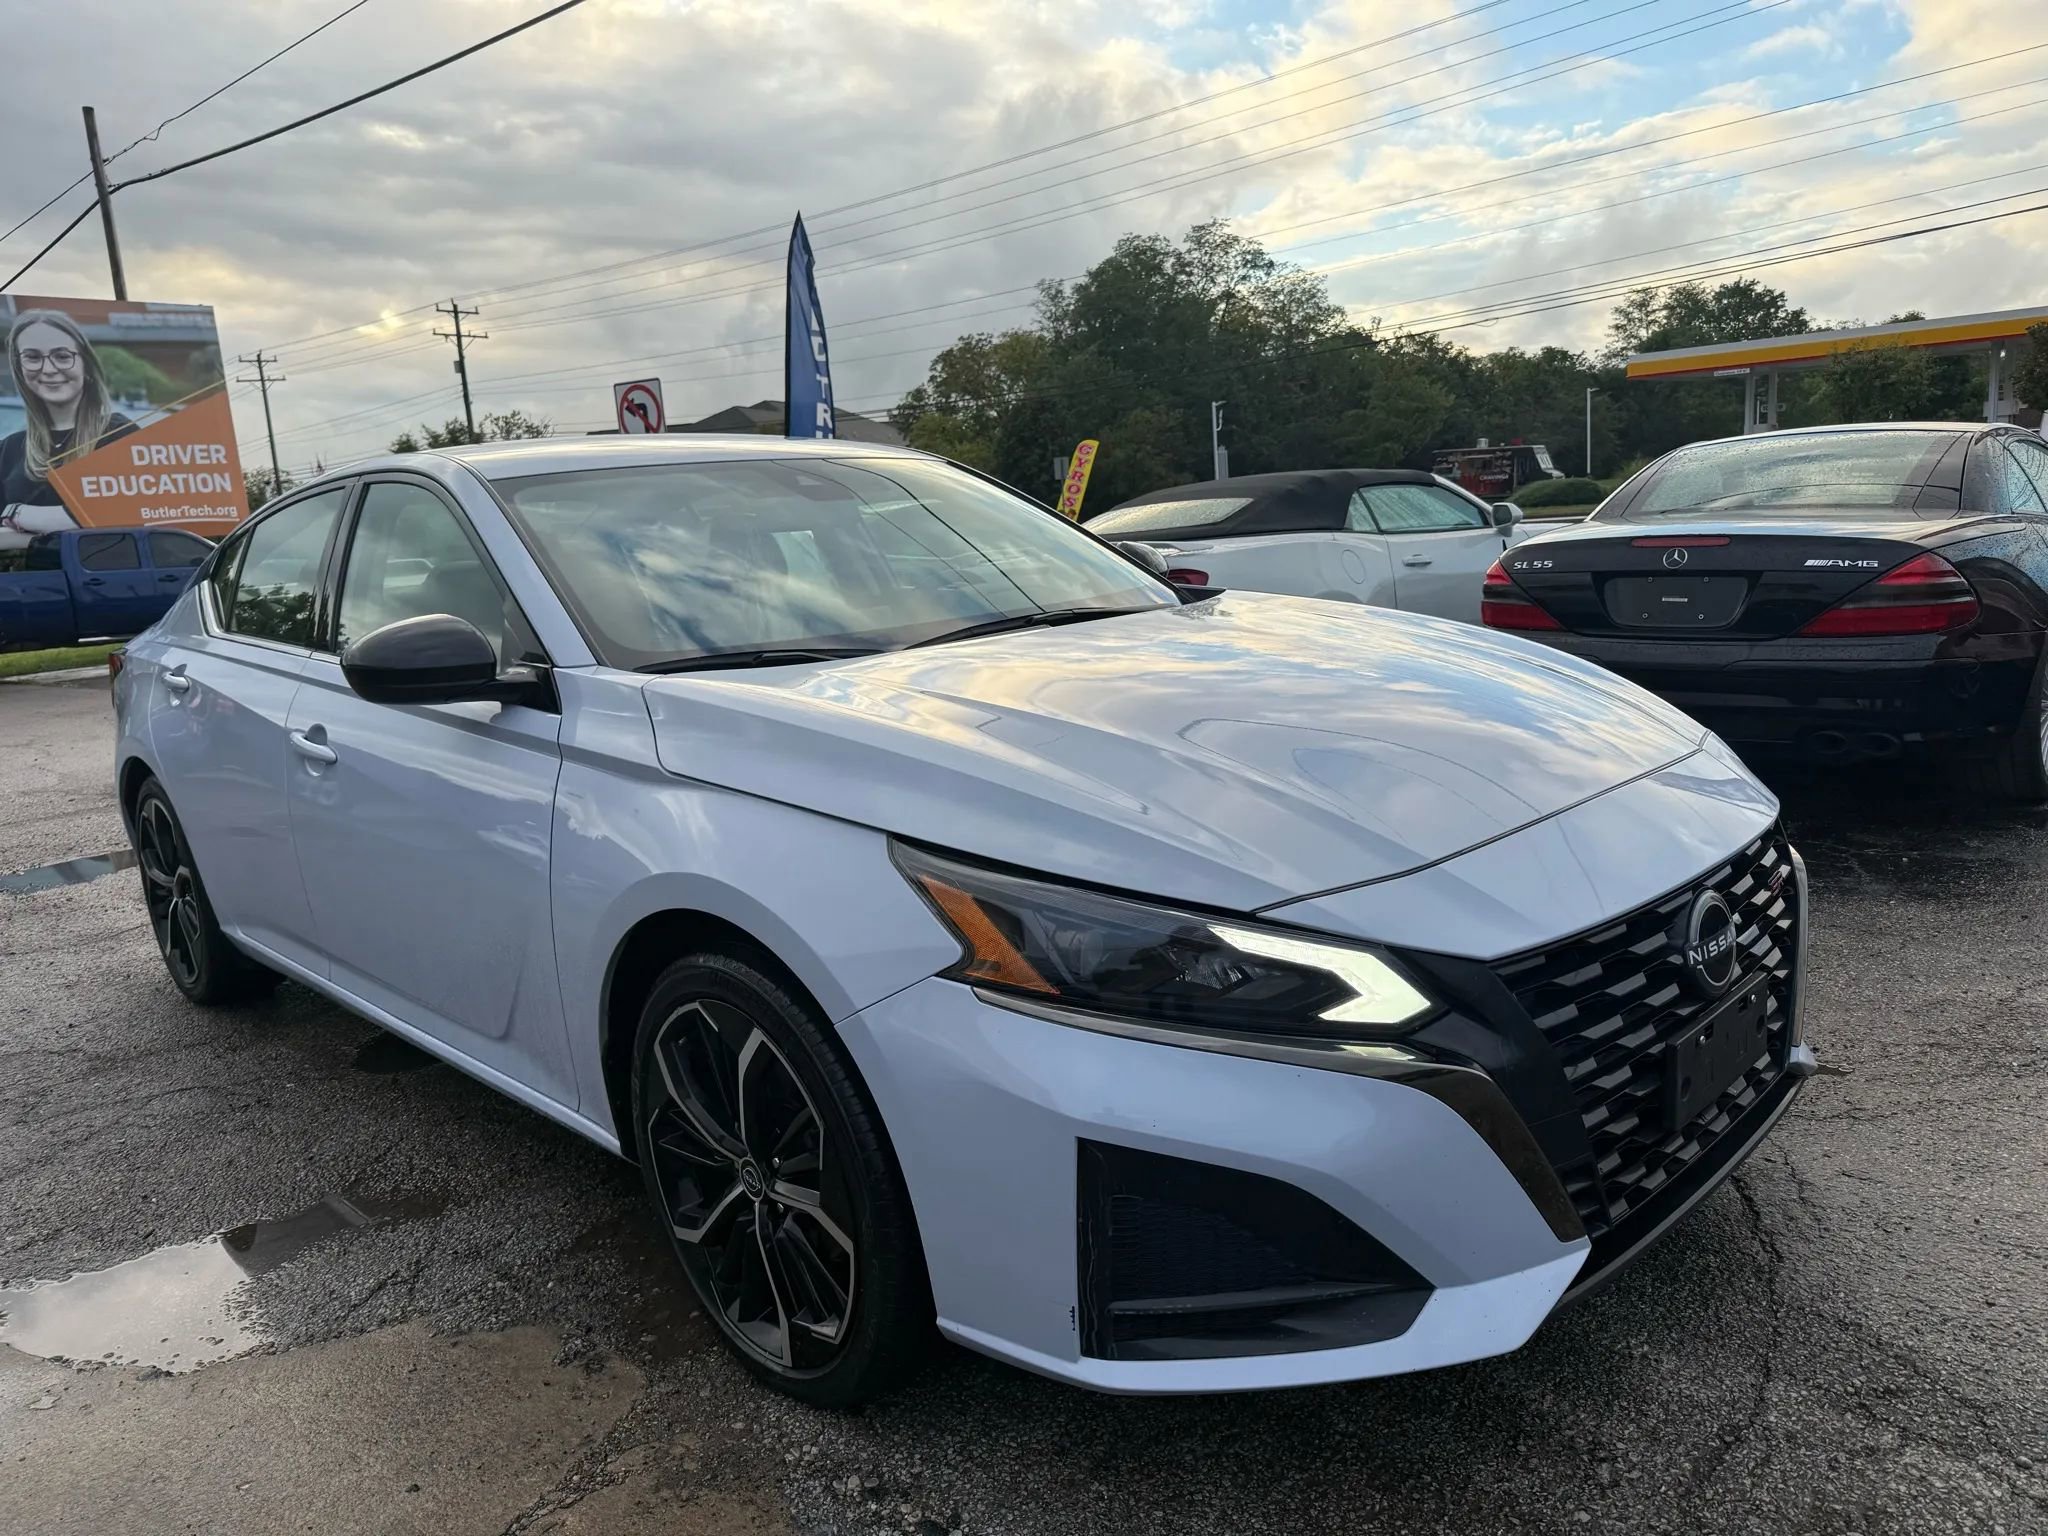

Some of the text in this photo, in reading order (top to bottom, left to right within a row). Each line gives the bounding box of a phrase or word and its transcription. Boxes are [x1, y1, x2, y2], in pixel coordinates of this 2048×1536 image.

[130, 444, 227, 466] DRIVER
[1064, 444, 1093, 507] GYROS
[80, 473, 232, 498] EDUCATION
[140, 505, 238, 519] ButlerTech.org
[1513, 560, 1553, 570] SL 55
[1826, 559, 1879, 568] AMG
